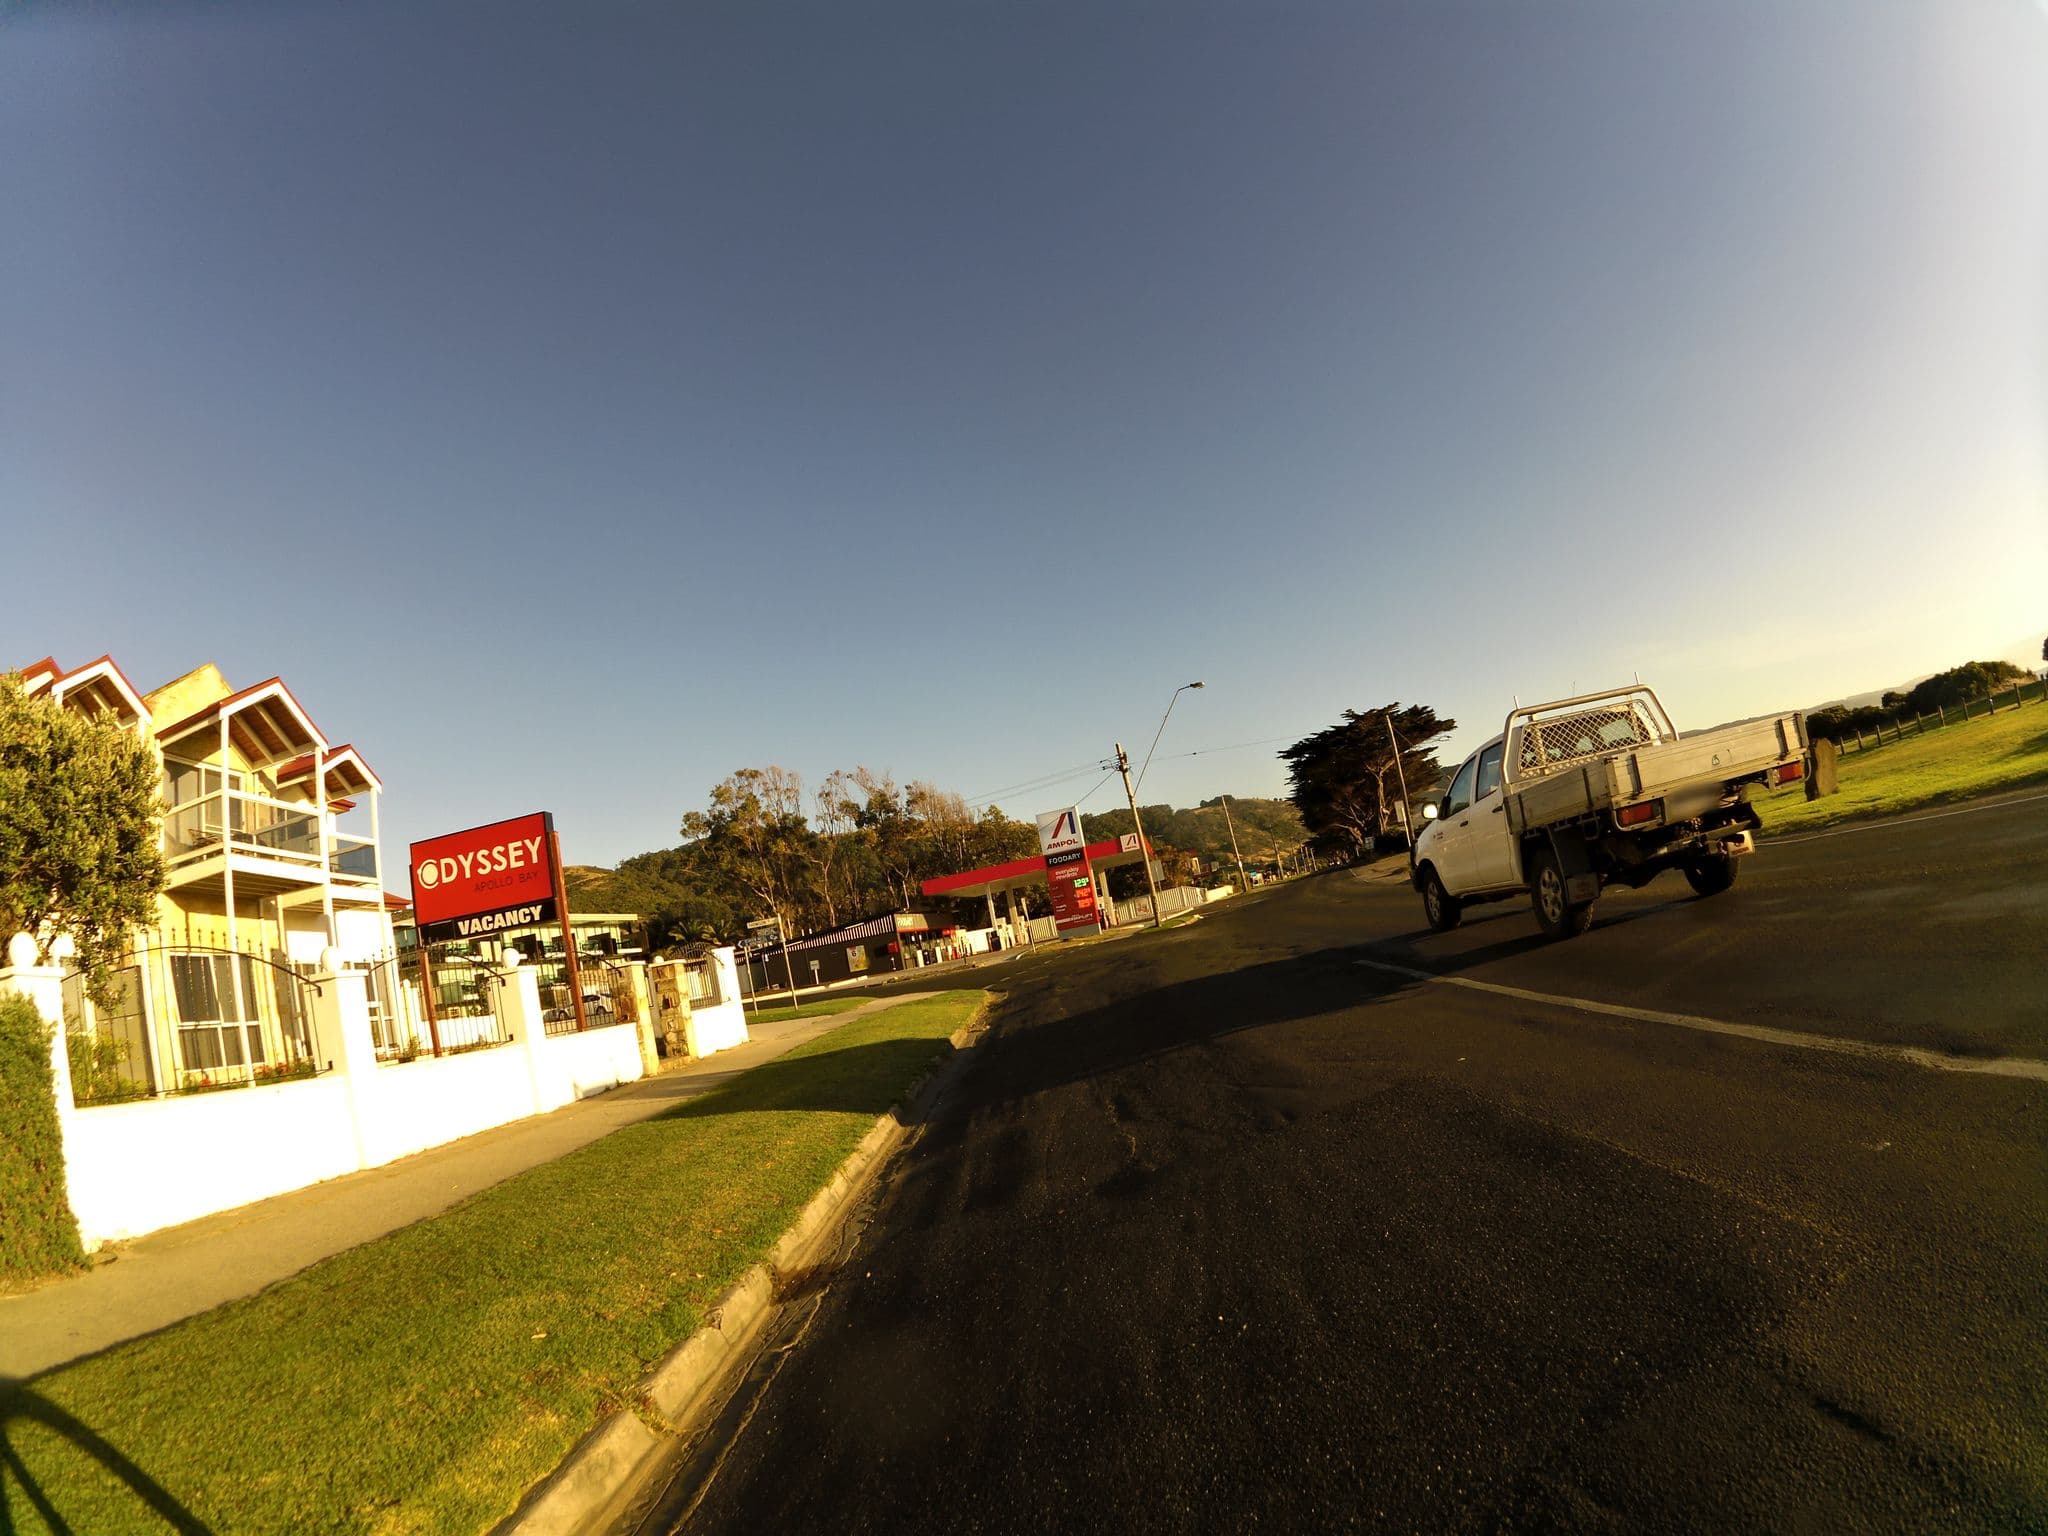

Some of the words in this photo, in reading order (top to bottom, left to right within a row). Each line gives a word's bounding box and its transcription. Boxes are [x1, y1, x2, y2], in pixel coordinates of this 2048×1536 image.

[1047, 838, 1078, 850] AMPOL
[417, 836, 542, 889] ODYSSEY
[474, 875, 513, 892] APOLLO
[518, 871, 539, 883] BAY
[458, 905, 543, 936] VACANCY
